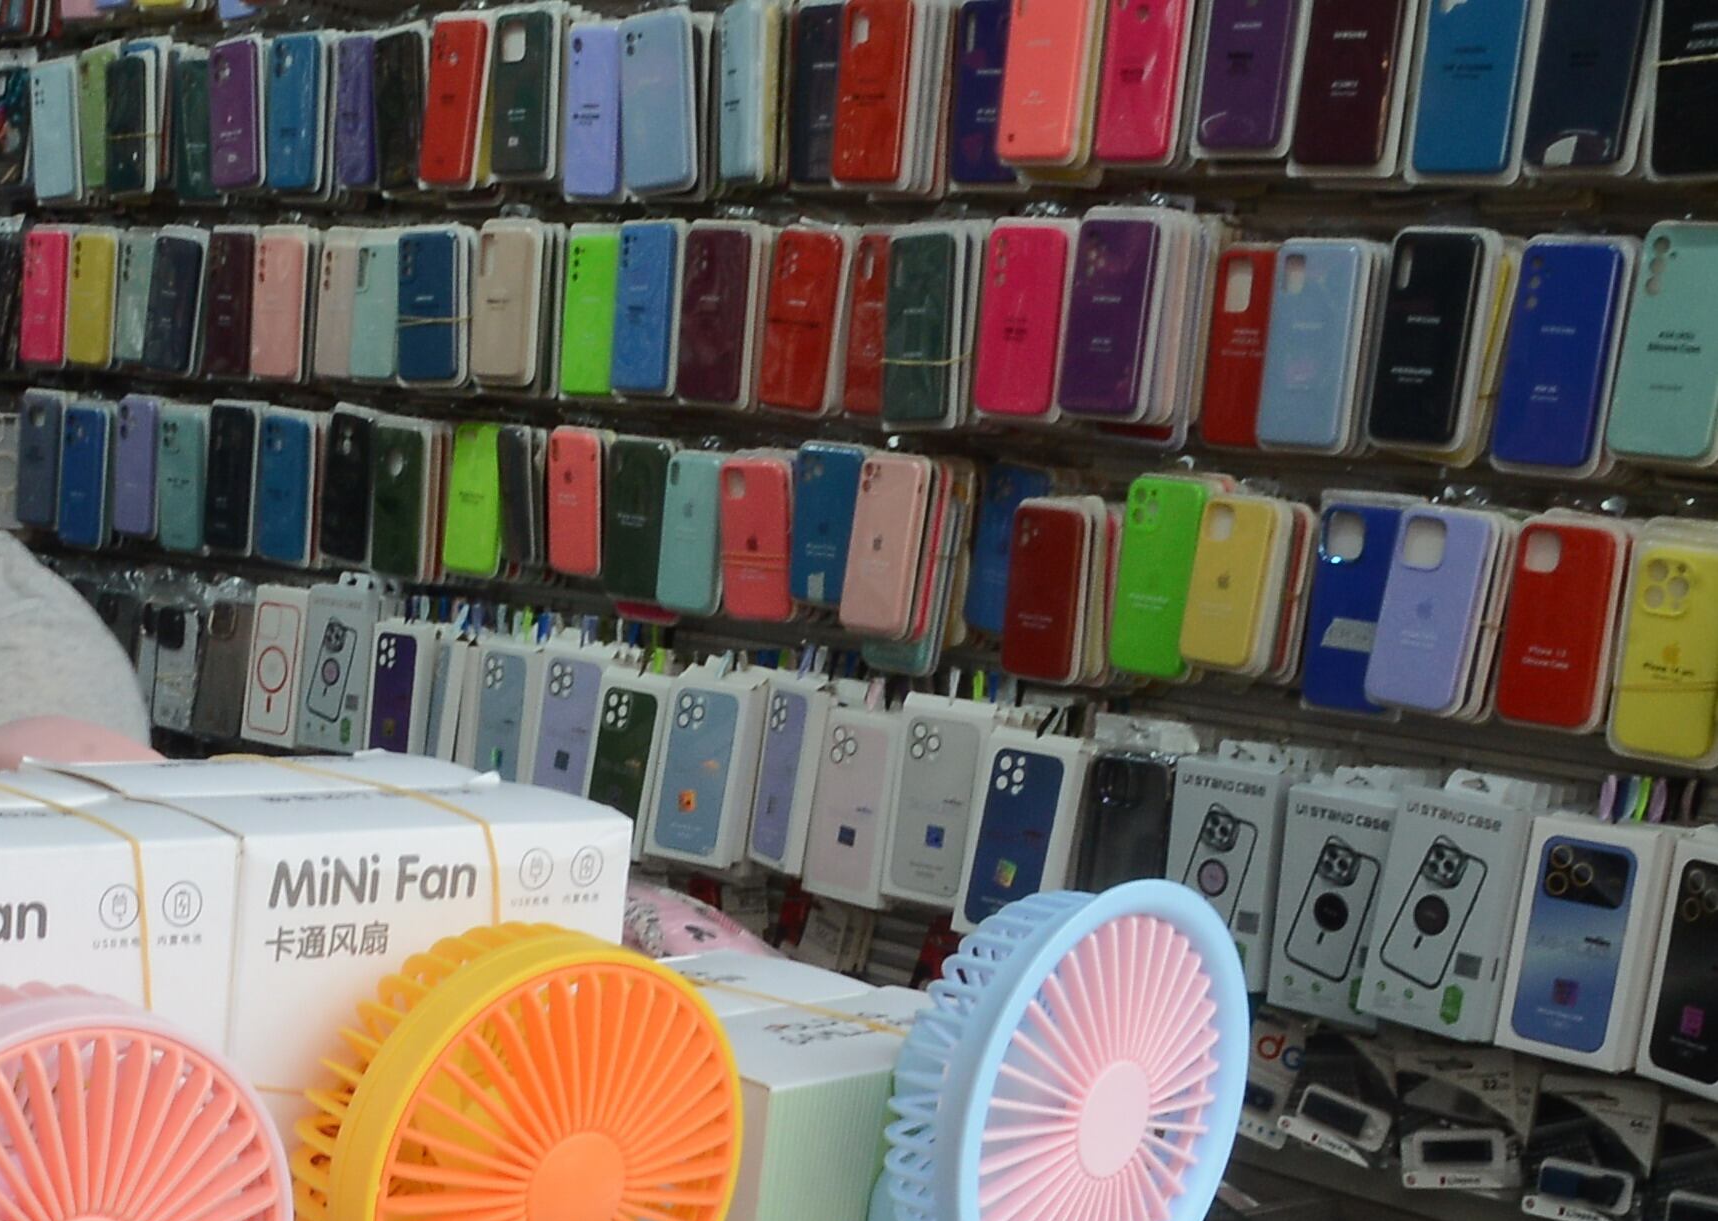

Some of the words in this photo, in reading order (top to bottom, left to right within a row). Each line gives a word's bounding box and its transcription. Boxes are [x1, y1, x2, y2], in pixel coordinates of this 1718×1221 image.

[268, 853, 381, 909] MiNi
[395, 853, 478, 902] Fan
[265, 920, 389, 962] 卡通风扇
